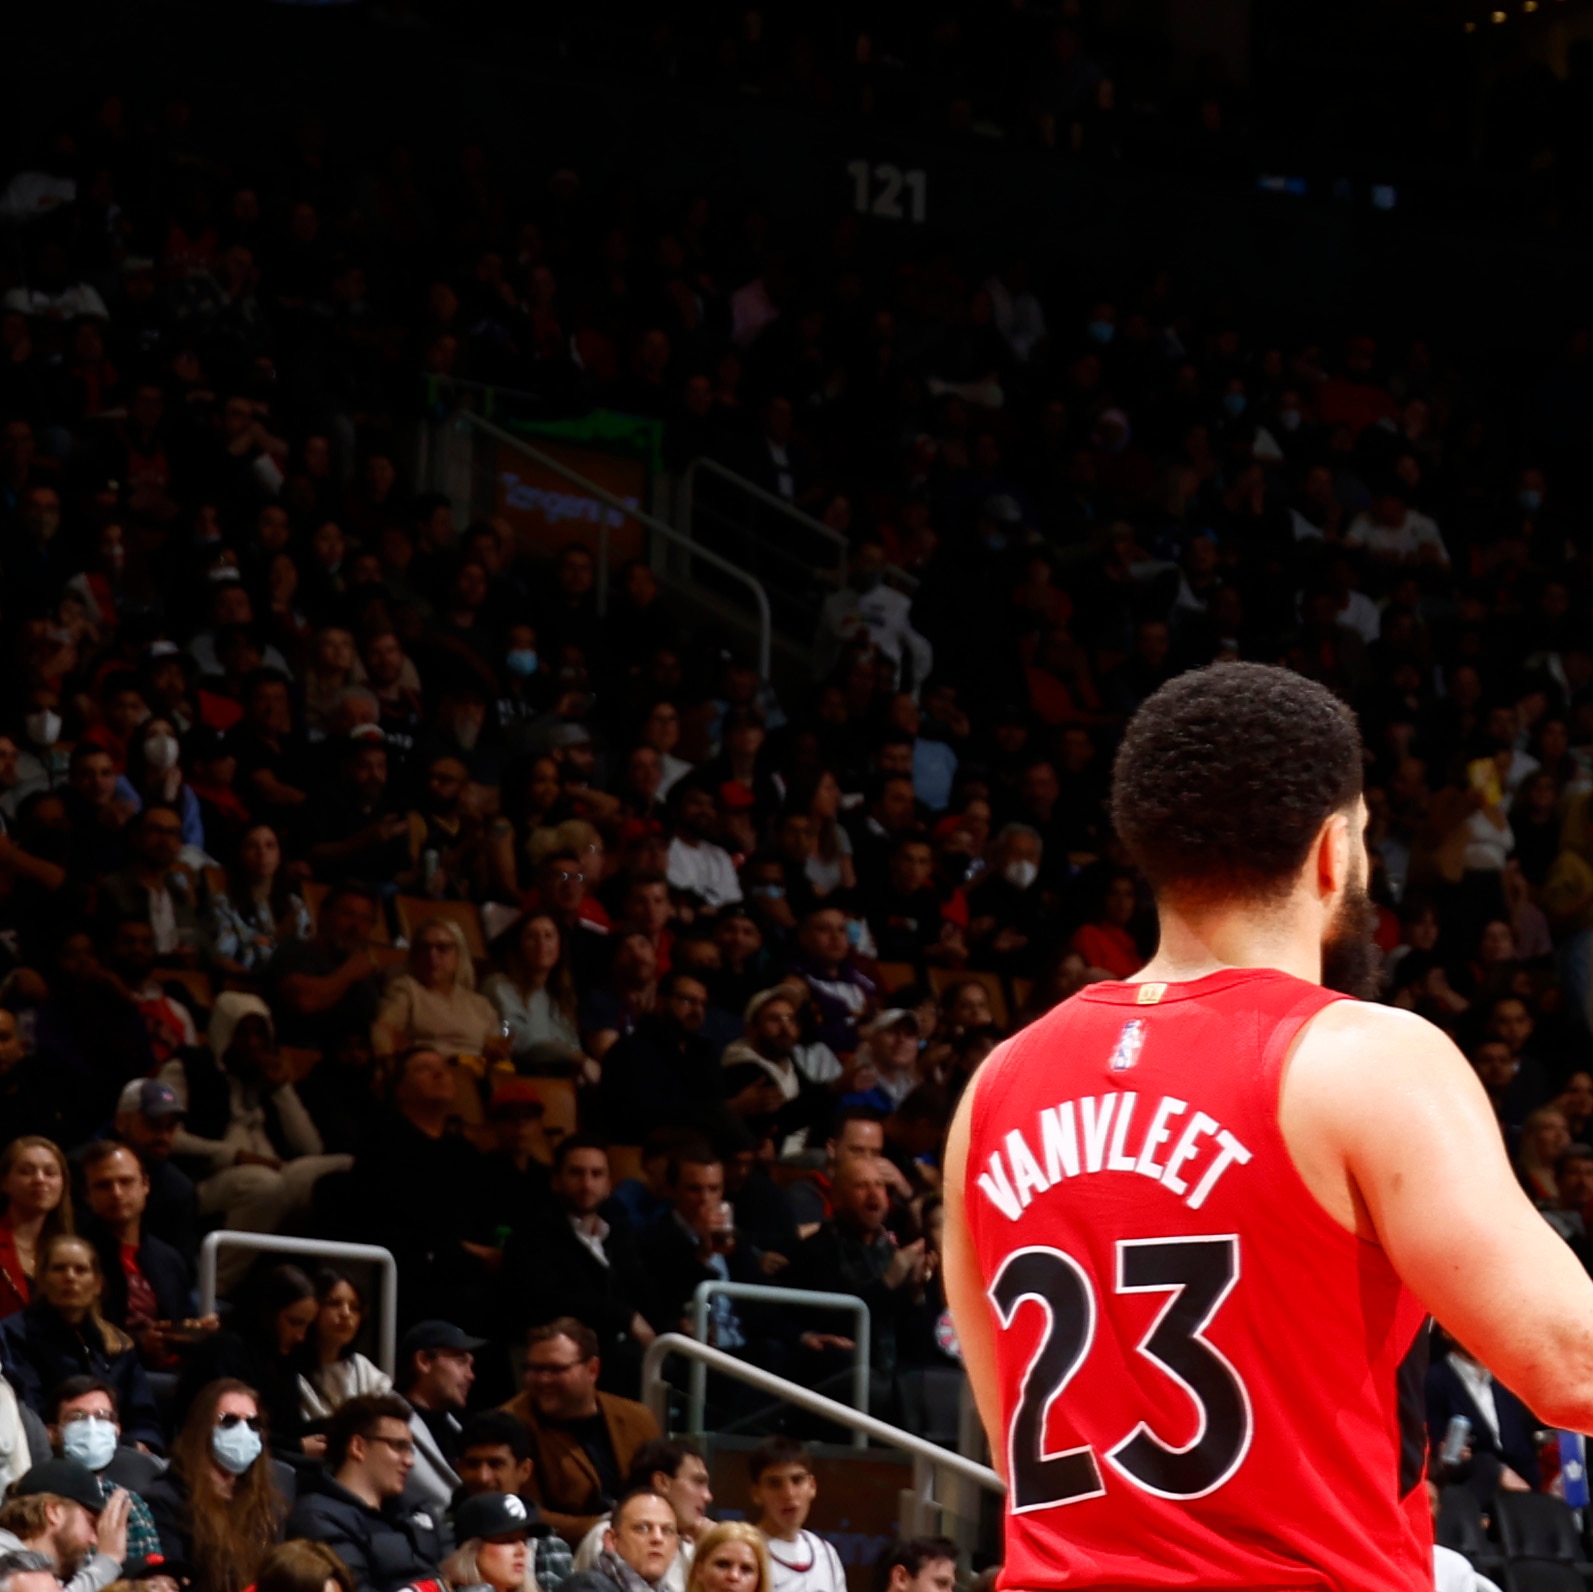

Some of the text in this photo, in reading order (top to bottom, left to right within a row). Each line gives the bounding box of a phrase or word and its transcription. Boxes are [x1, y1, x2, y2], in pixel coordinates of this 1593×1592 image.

[846, 159, 927, 224] 121
[977, 1091, 1253, 1221] VANVLEET
[987, 1233, 1254, 1515] 23
